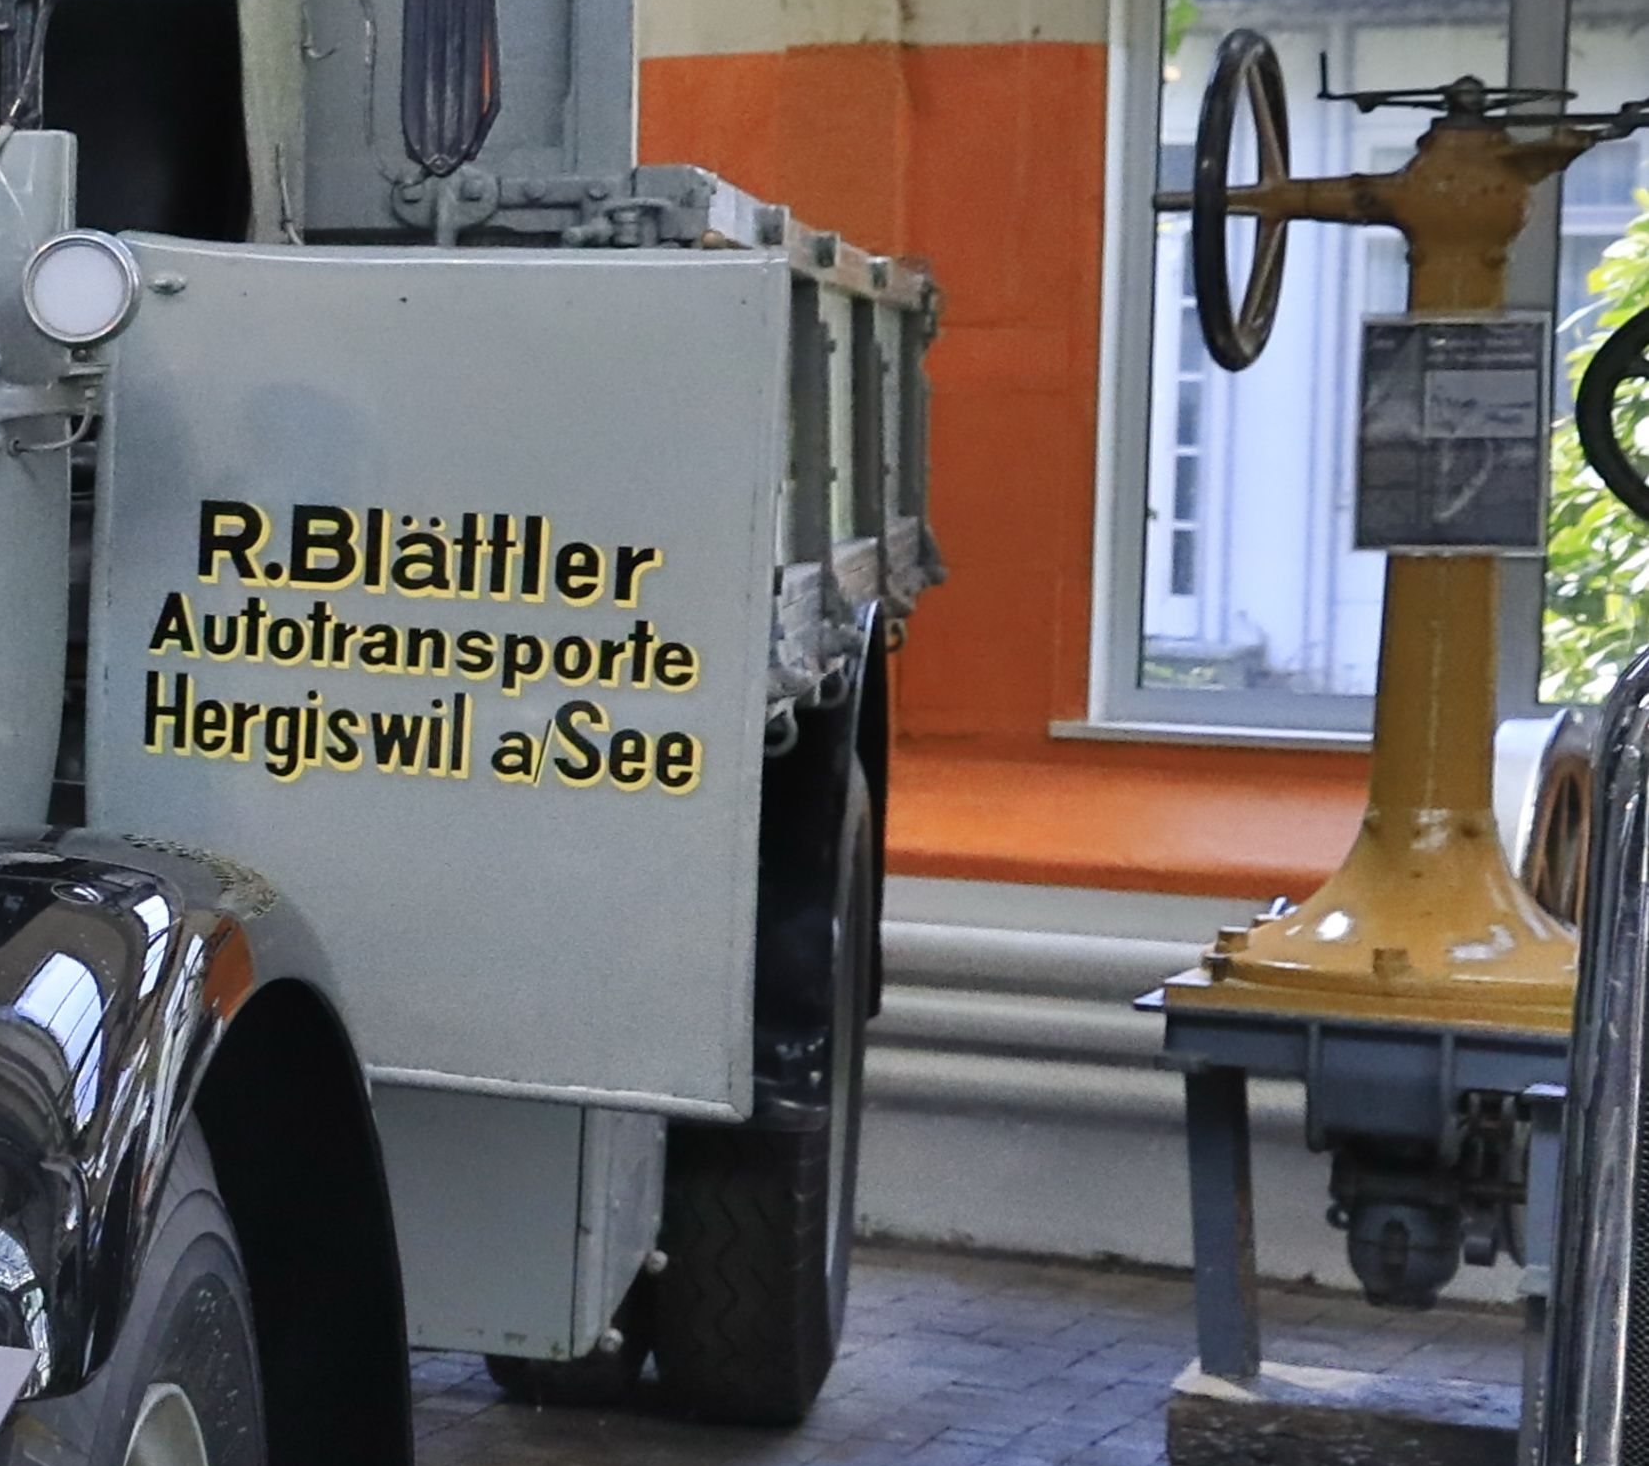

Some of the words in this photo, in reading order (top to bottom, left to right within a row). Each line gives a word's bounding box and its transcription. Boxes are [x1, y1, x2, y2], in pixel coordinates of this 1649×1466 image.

[196, 499, 662, 609] R.Blättler
[148, 591, 699, 696] Autotransporte
[144, 670, 472, 782] Hergiswil
